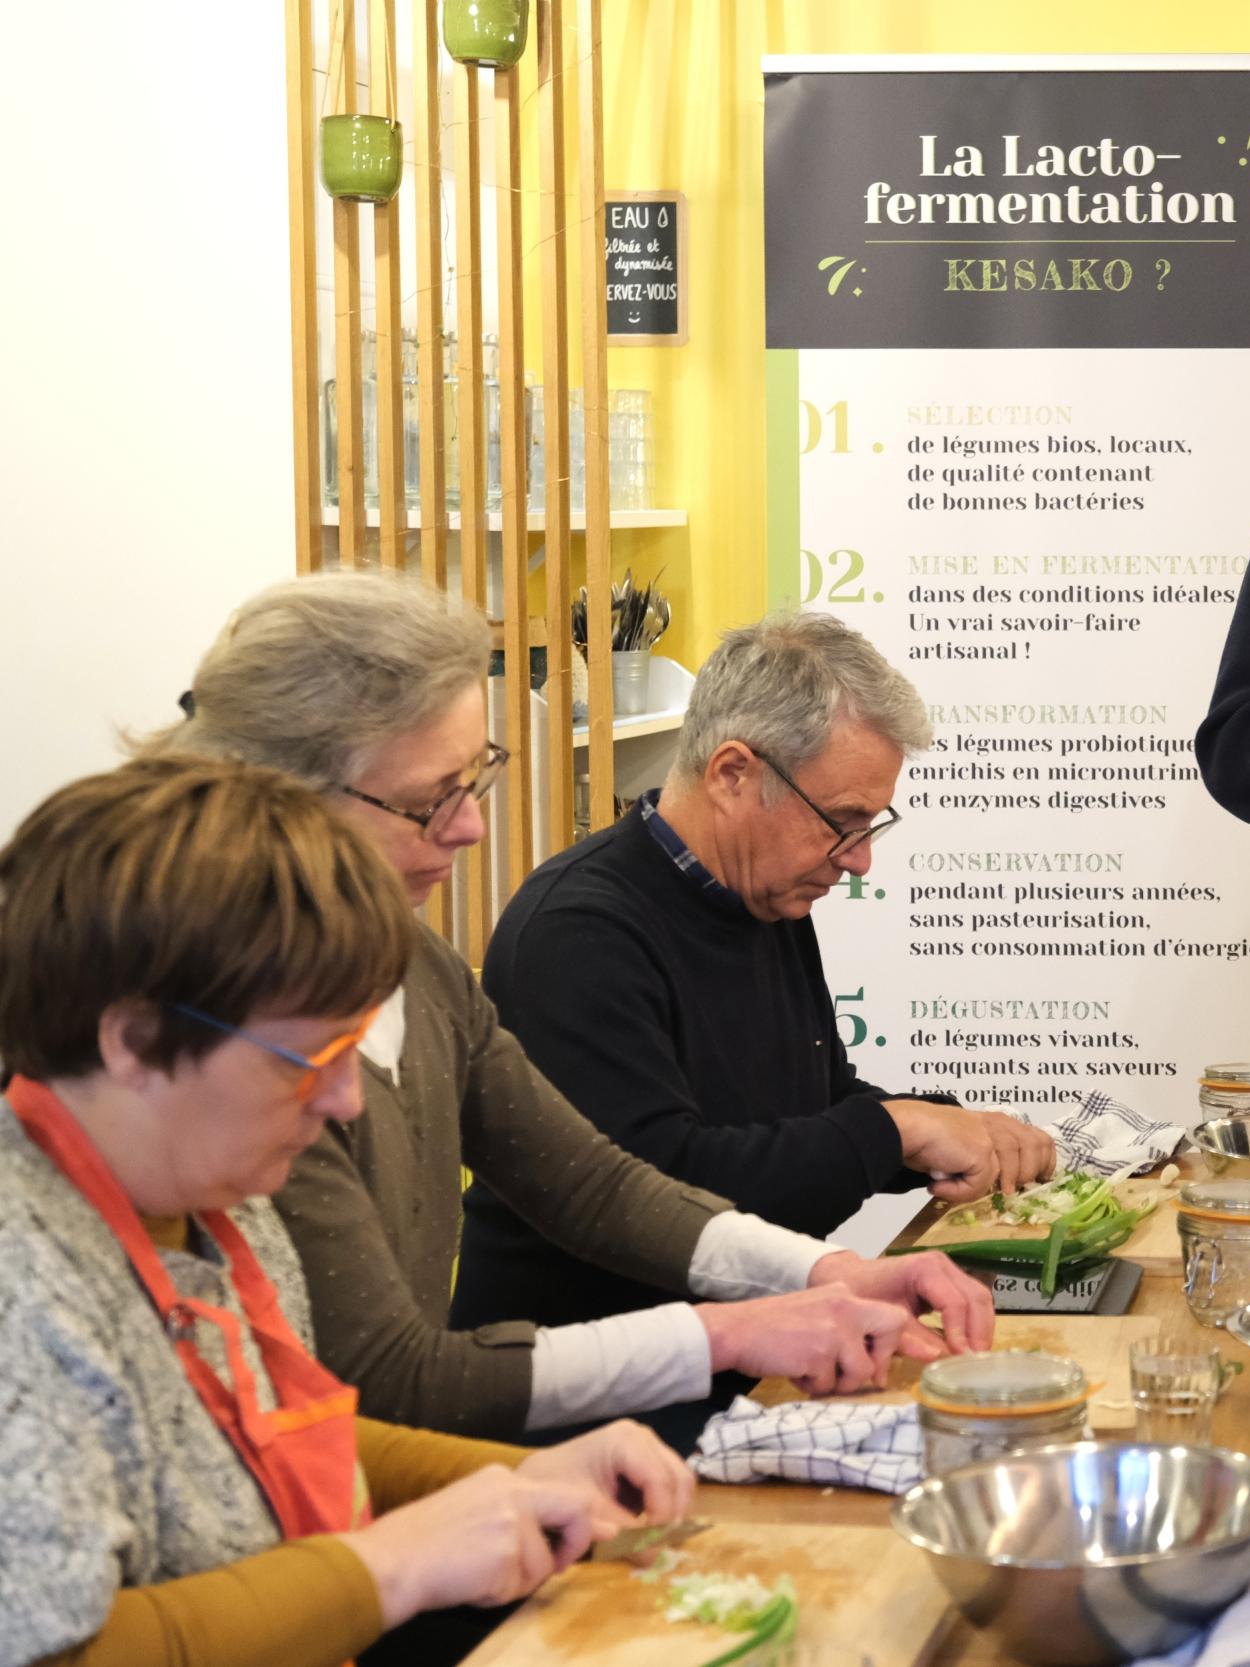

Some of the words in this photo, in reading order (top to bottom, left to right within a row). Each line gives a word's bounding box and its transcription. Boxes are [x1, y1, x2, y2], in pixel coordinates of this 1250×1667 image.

[919, 135, 985, 177] La
[1002, 135, 1181, 176] Lacto-
[864, 182, 1236, 224] fermentation
[611, 206, 649, 228] EAU
[647, 238, 660, 252] et
[614, 256, 673, 277] dynamisée
[944, 259, 1132, 291] KESAKO
[1156, 259, 1171, 290] ?
[606, 283, 677, 301] ERVEZ-VOUS
[908, 406, 1072, 425] SÉLECTION
[908, 436, 934, 453] de
[944, 436, 1039, 457] légumes
[1048, 436, 1101, 453] bios,
[1111, 436, 1192, 455] locaux,
[908, 464, 934, 482] de
[942, 464, 1024, 486] qualité
[1032, 464, 1154, 482] contenant
[908, 493, 934, 510] de
[943, 493, 1027, 510] bonnes
[1035, 492, 1144, 510] bactéries
[909, 556, 978, 575] MISE
[993, 555, 1028, 575] EN
[1043, 555, 1247, 575] FERMENTATIO
[909, 586, 964, 603] dans
[973, 586, 1011, 602] des
[1019, 585, 1144, 603] conditions
[1153, 585, 1235, 603] idéales
[910, 614, 939, 631] Un
[948, 614, 992, 631] vrai
[1001, 614, 1140, 631] savoir-faire
[909, 642, 1016, 659] artisanal
[1025, 642, 1030, 659] !
[929, 704, 1168, 724] RANSFORMATION
[957, 734, 1052, 755] légumes
[909, 763, 1005, 780] enrichis
[1013, 767, 1039, 780] en
[909, 792, 932, 808] et
[940, 795, 1040, 812] enzymes
[1048, 791, 1165, 812] digestives
[909, 853, 1123, 872] CONSERVATION
[911, 882, 1004, 904] pendant
[1015, 882, 1124, 904] plusieurs
[1132, 883, 1220, 902] années,
[910, 914, 963, 928] sans
[973, 911, 1150, 932] pasteurisation,
[910, 942, 963, 956] sans
[972, 939, 1145, 956] consommation
[911, 995, 1110, 1020] DÉGUSTATION
[911, 1029, 936, 1046] de
[946, 1029, 1041, 1050] légumes
[1048, 1030, 1138, 1048] vivants,
[911, 1059, 1029, 1078] croquants
[1037, 1062, 1078, 1076] aux
[1086, 1062, 1177, 1077] saveurs
[965, 1085, 1082, 1105] originales
